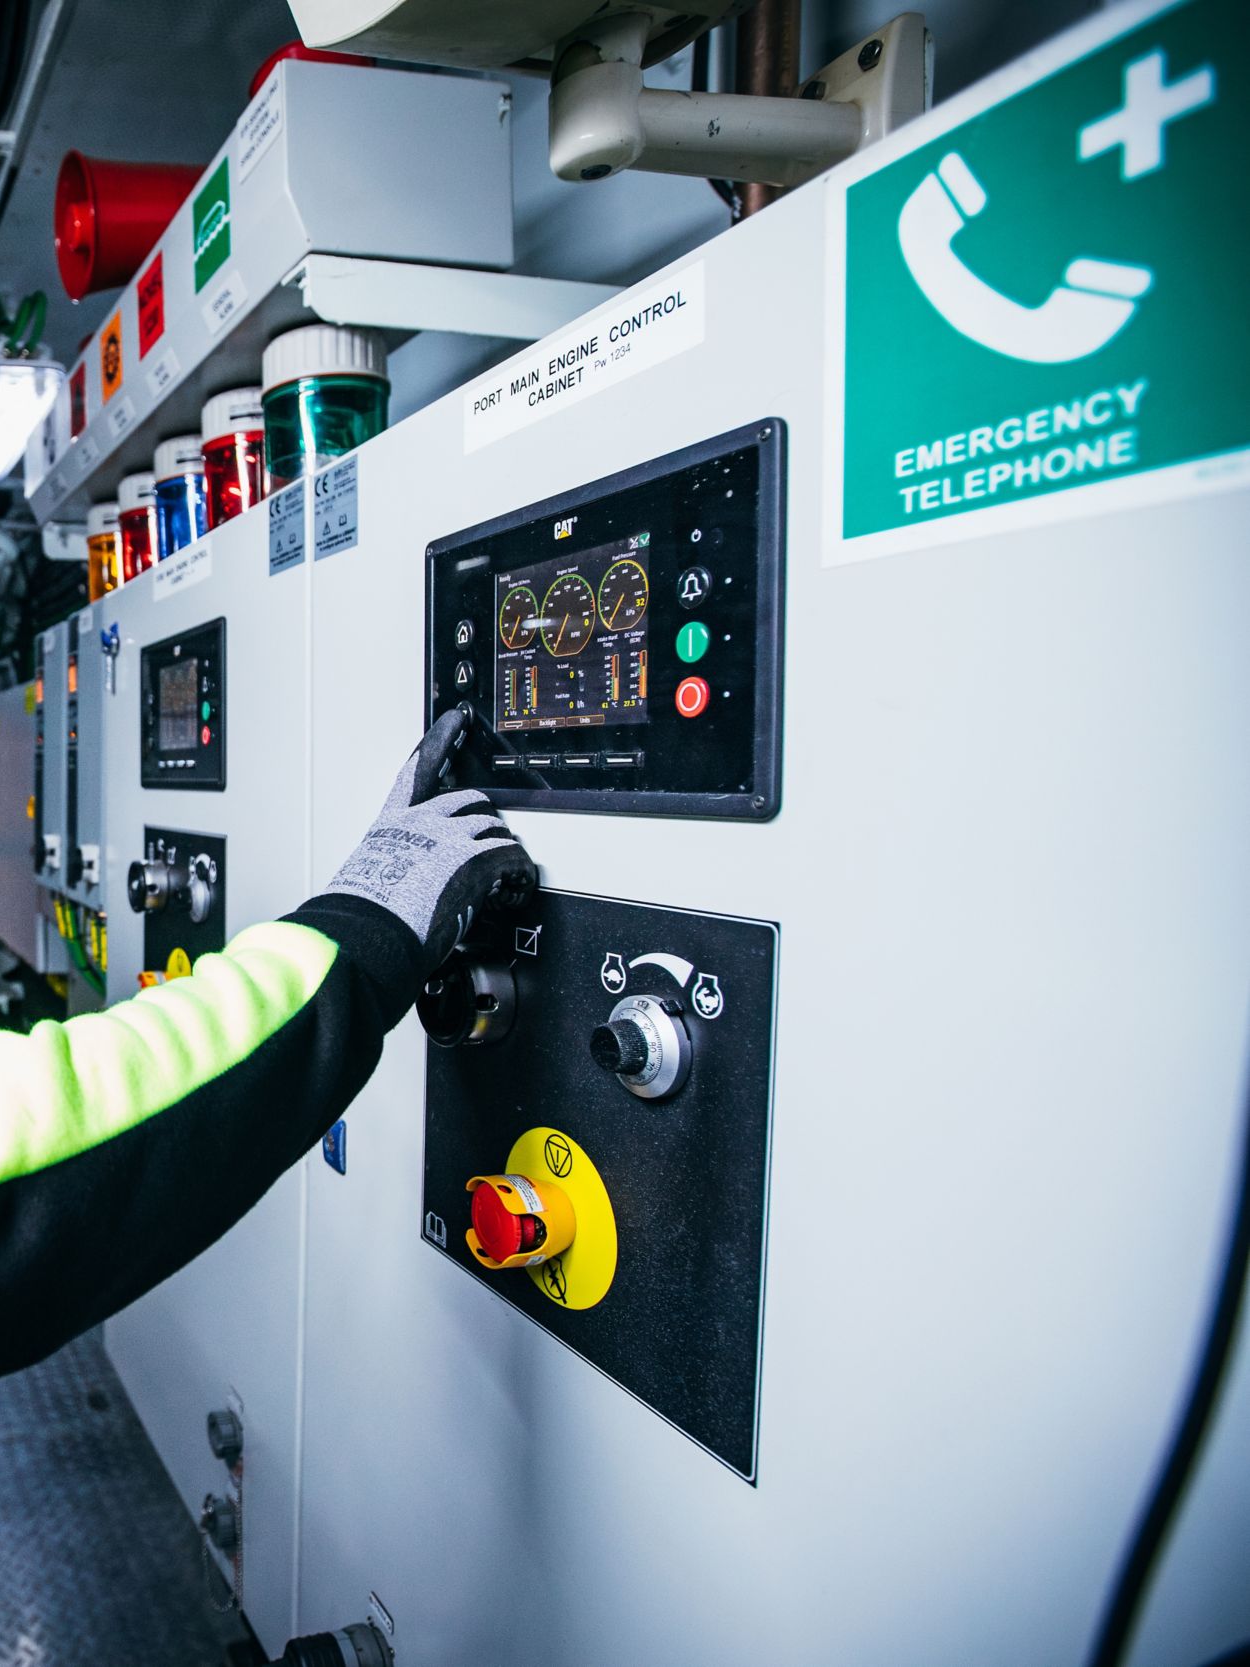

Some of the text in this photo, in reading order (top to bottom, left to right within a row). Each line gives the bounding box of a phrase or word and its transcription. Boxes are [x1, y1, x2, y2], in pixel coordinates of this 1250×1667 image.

[474, 290, 687, 415] PORT MAIN ENGINE CONTROL
[528, 366, 585, 407] CABINET
[610, 343, 631, 362] 1234
[893, 377, 1149, 480] EMERGENCY
[899, 426, 1140, 515] TELEPHONE
[635, 597, 645, 607] 32
[570, 671, 575, 679] 0
[569, 701, 575, 709] 0
[369, 827, 438, 851] BERNER
